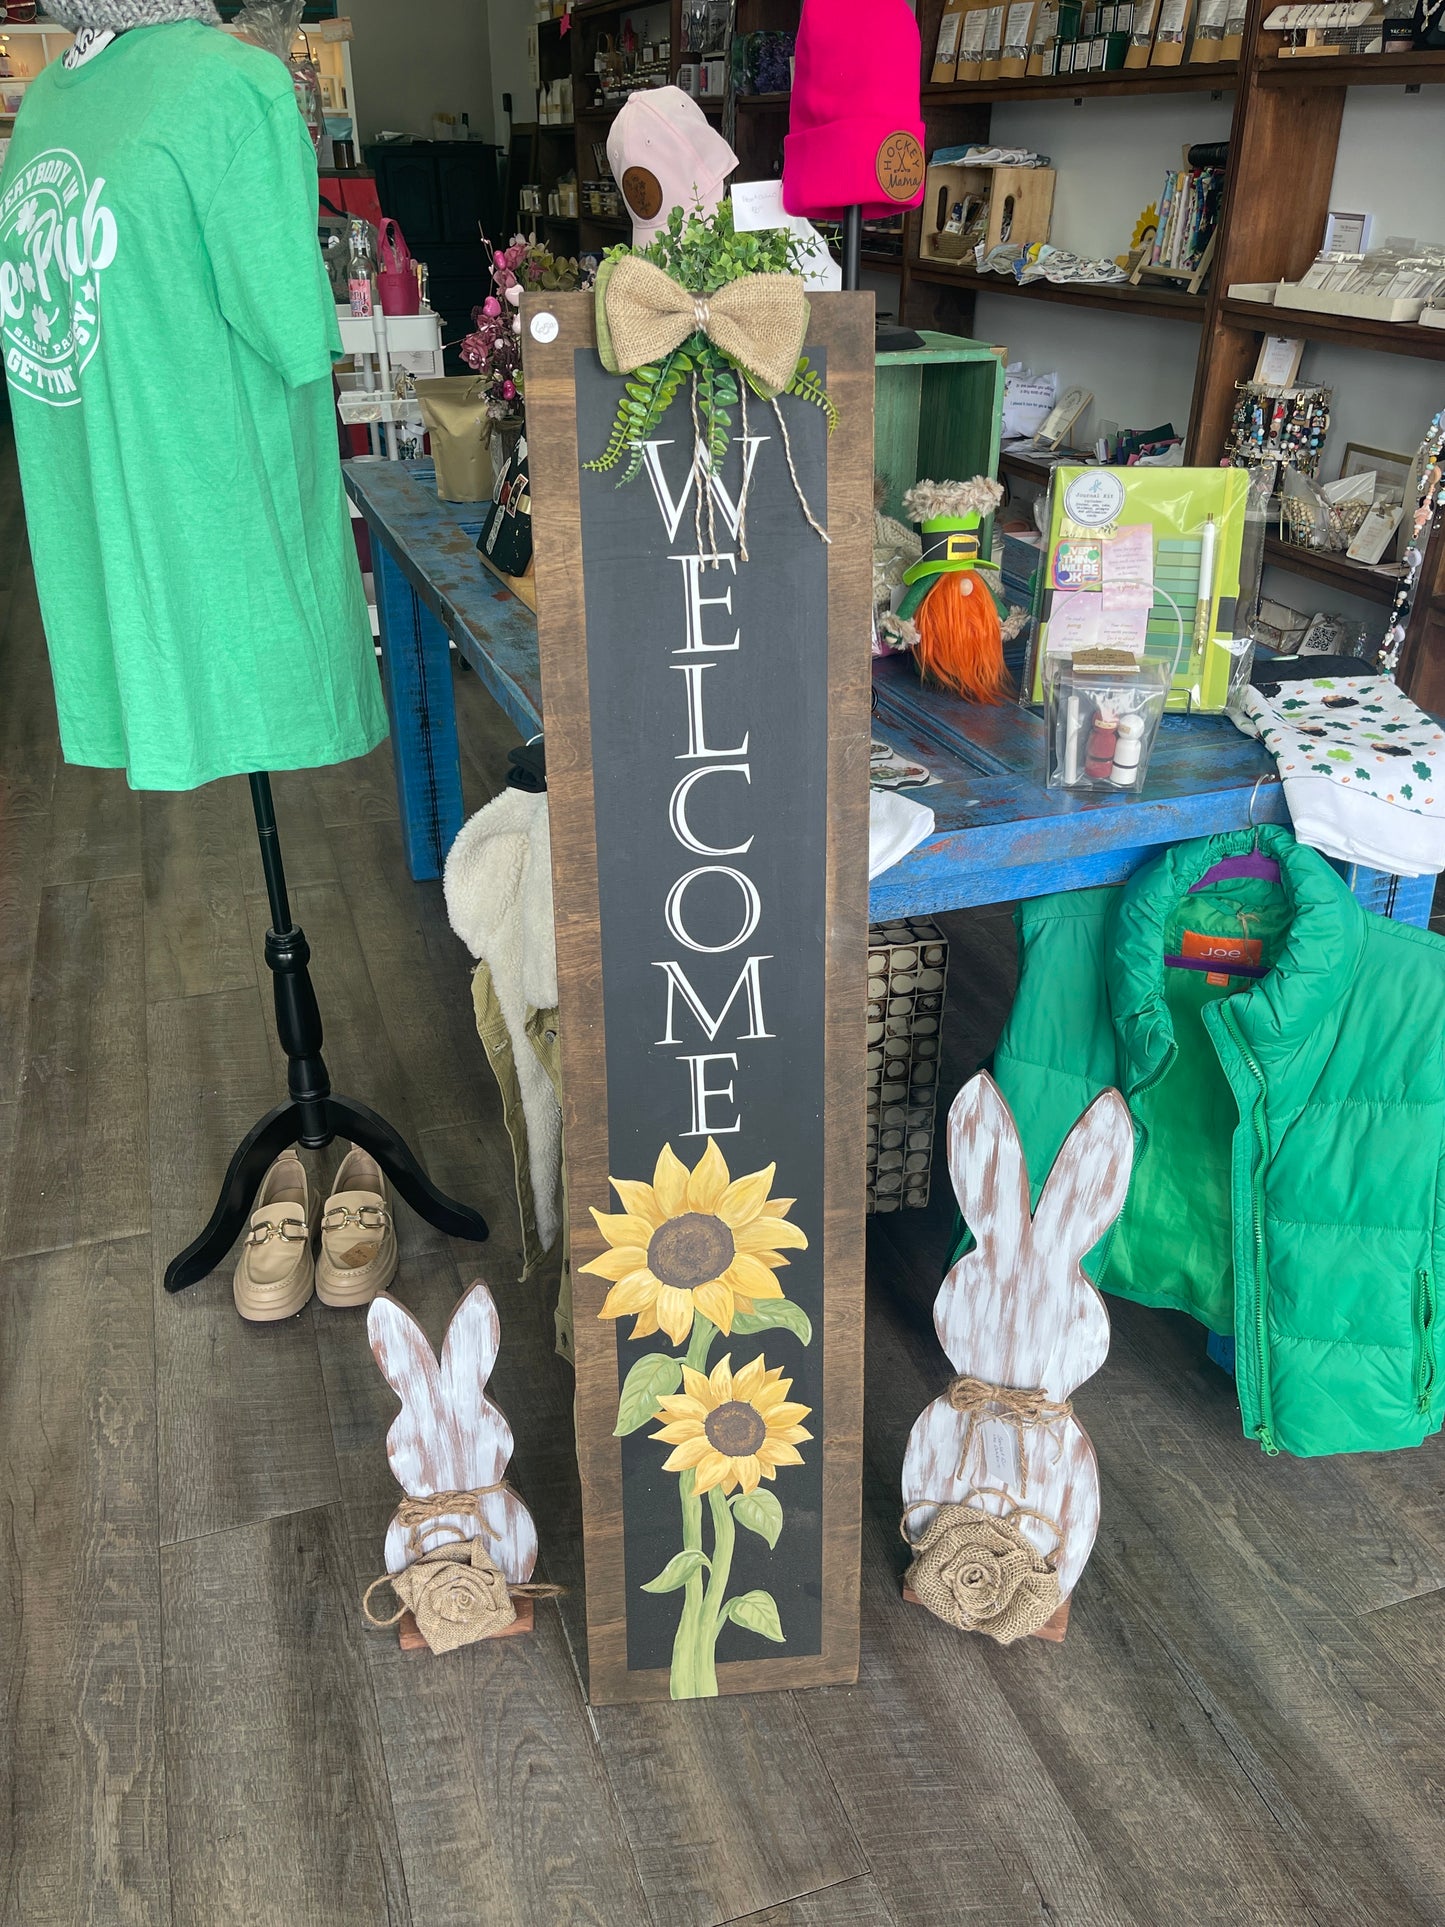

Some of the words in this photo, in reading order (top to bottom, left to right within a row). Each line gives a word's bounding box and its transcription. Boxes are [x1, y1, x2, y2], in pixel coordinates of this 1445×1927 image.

[883, 139, 920, 171] HOCKEY
[887, 173, 921, 189] Mama
[13, 326, 48, 356] SAINT
[1064, 546, 1098, 557] VERY
[1060, 564, 1083, 572] WILL
[1082, 564, 1099, 575] BE
[629, 436, 776, 1138] WELCOME
